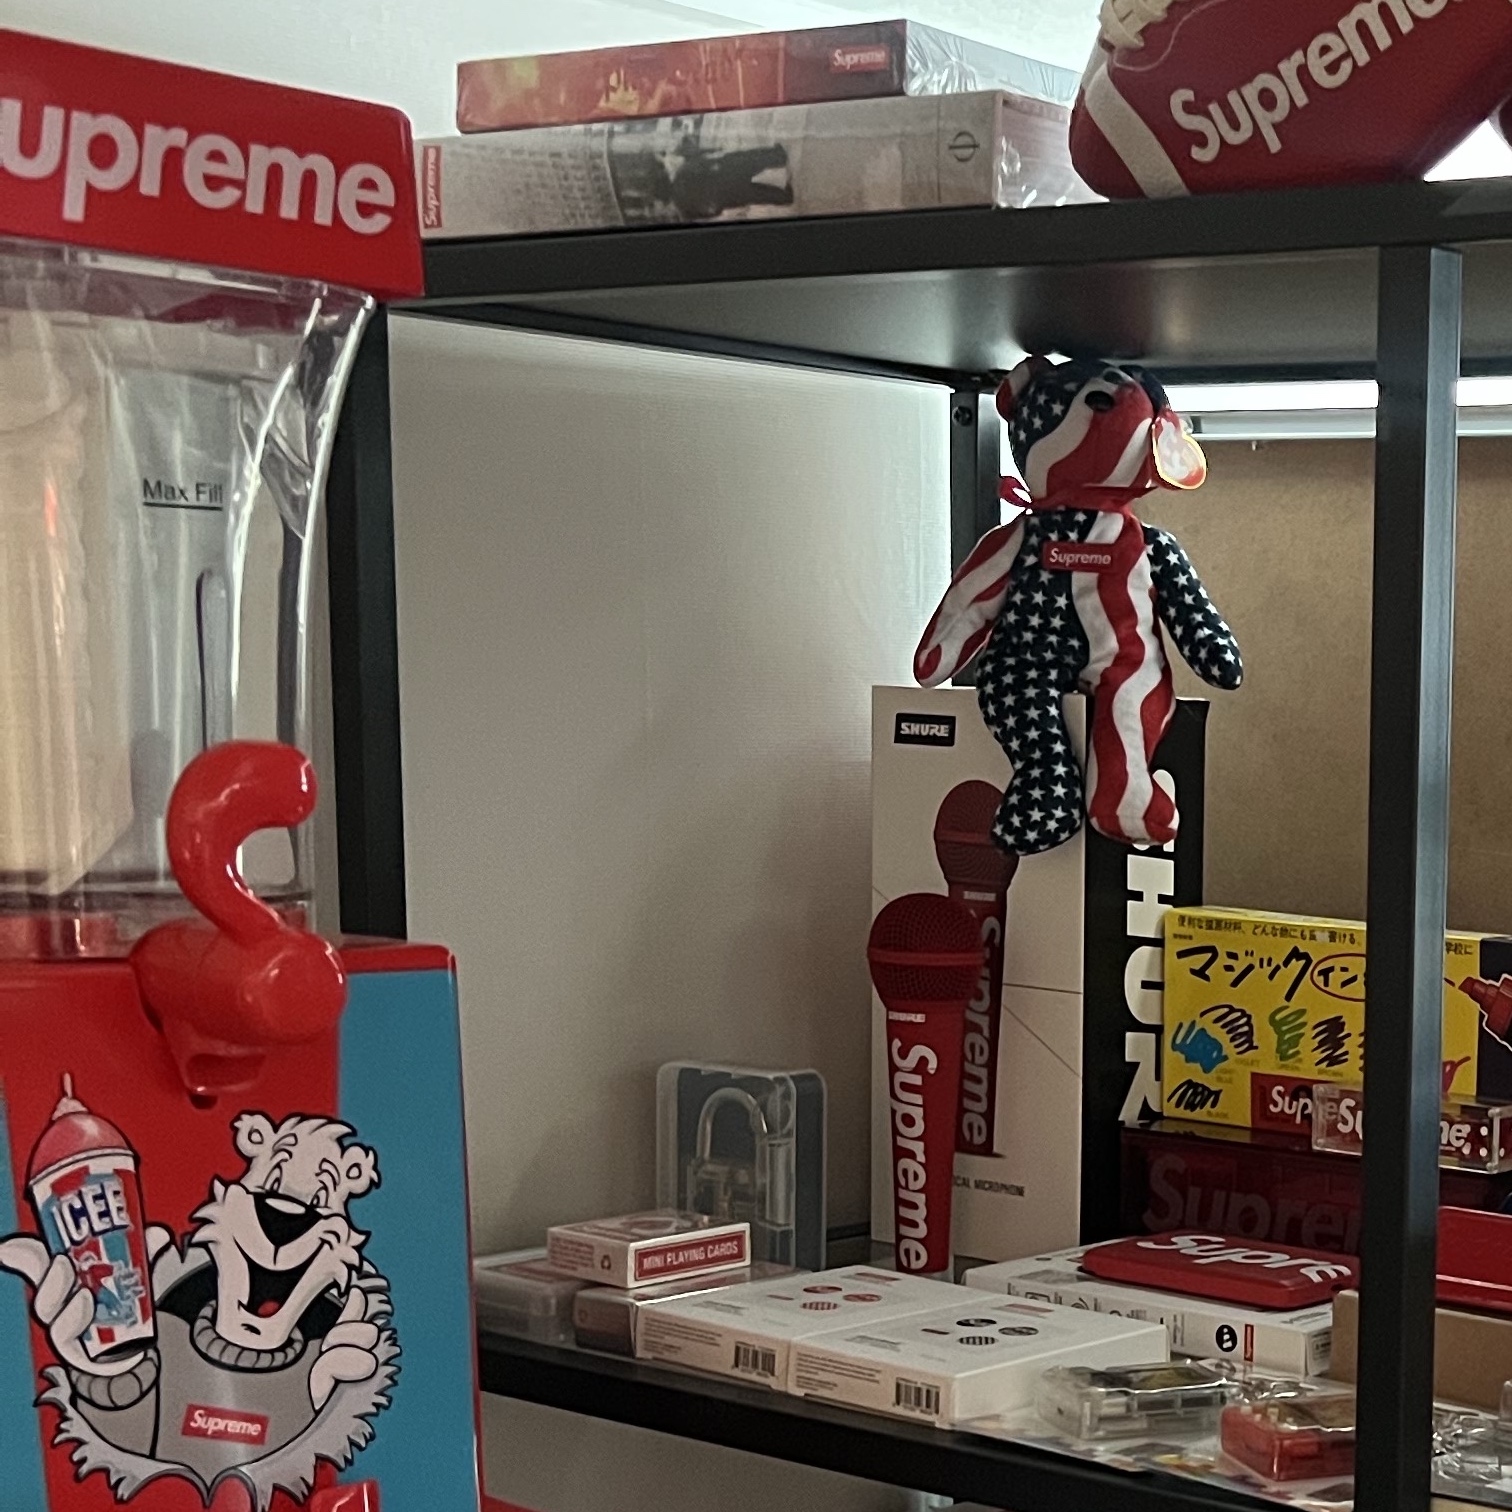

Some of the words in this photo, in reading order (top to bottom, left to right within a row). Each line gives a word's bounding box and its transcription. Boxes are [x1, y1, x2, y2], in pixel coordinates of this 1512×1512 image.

[833, 47, 886, 70] Supreme
[143, 477, 188, 503] Max
[194, 480, 224, 504] Fill
[1048, 547, 1112, 568] Supreme
[900, 721, 950, 738] SHURE
[1176, 945, 1314, 1003] マジック
[890, 1038, 938, 1272] Supreme
[54, 1184, 130, 1247] ICEE
[643, 1254, 666, 1271] MINI
[666, 1246, 705, 1266] PLAYING
[706, 1240, 739, 1260] CARDS
[189, 1410, 263, 1438] Supreme
